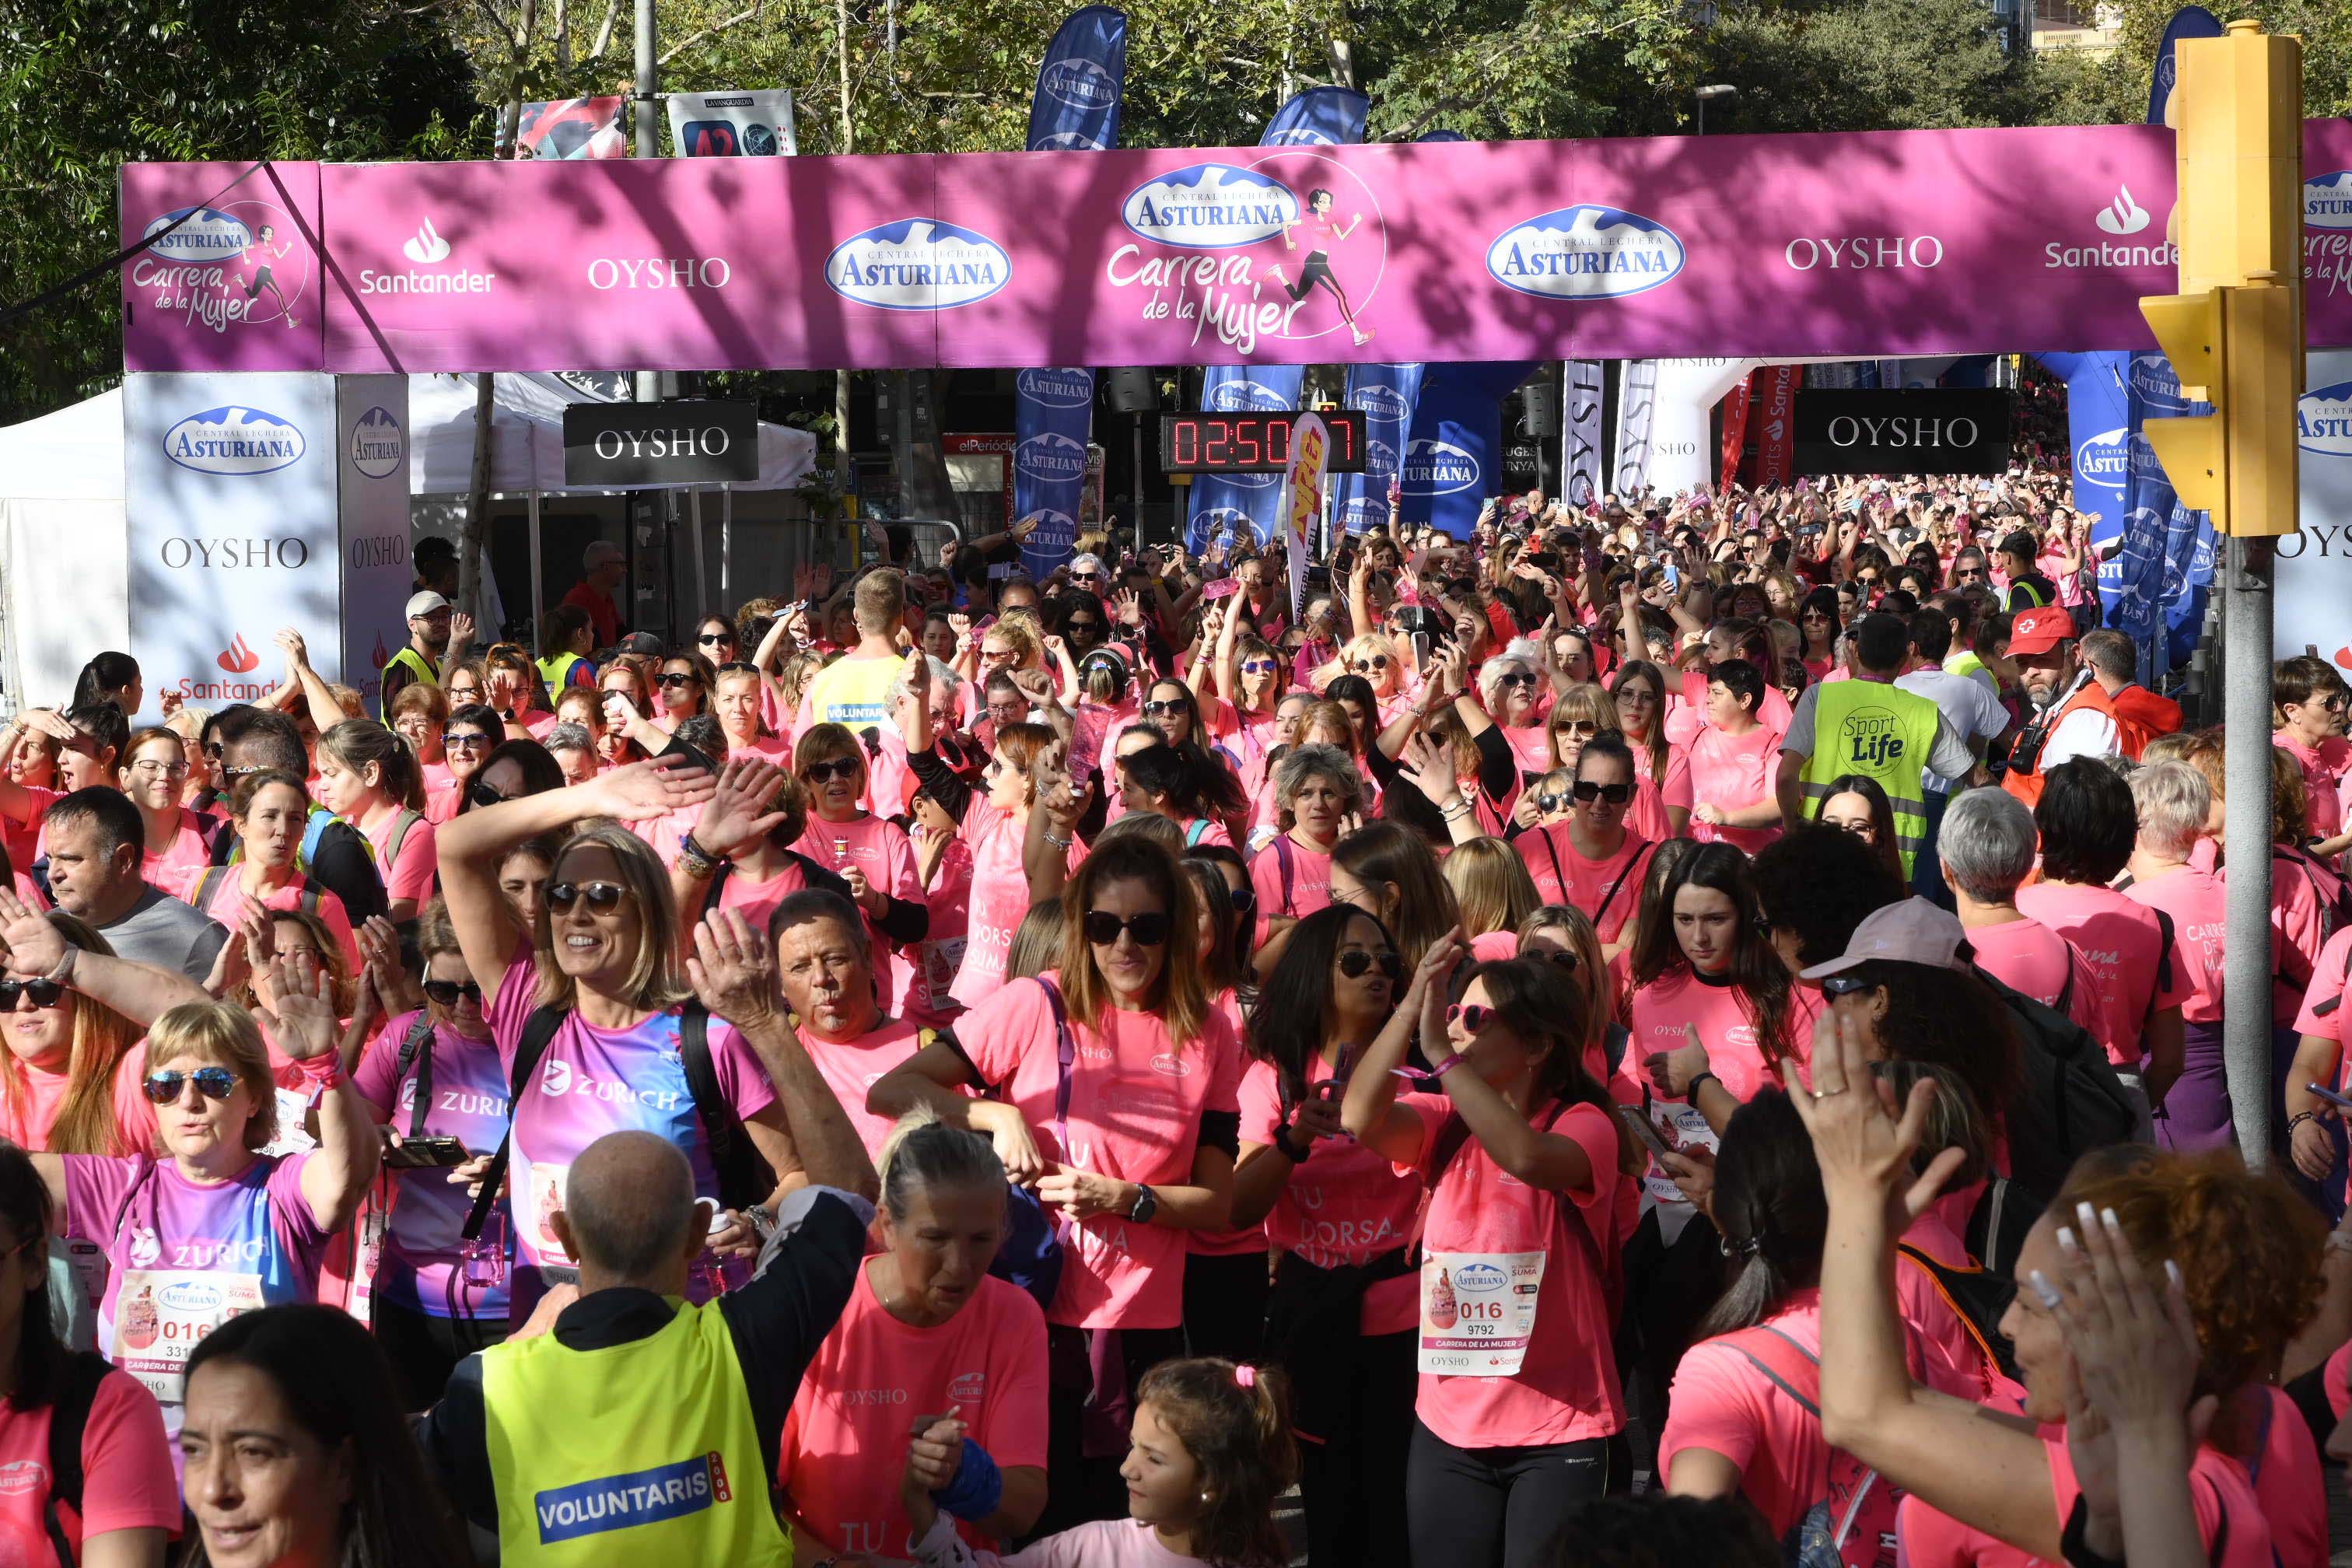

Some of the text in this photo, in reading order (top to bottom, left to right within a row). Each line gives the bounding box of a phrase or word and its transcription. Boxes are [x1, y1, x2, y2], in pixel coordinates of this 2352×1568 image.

[1047, 70, 1114, 100] ASTURIANA
[1135, 195, 1285, 227] ASTURIANA
[1162, 192, 1218, 202] CENTRAL
[1533, 236, 1662, 248] CENTRAL LECHERA
[1786, 235, 1943, 271] OYSHO
[132, 258, 224, 288] Carrera
[838, 253, 997, 287] ASTURIANA
[1107, 243, 1252, 287] Carrera
[1502, 242, 1669, 276] ASTURIANA
[2317, 257, 2331, 278] la
[360, 268, 495, 294] Santander
[587, 257, 731, 290] OYSHO
[156, 285, 258, 333] de la Mujer
[1143, 282, 1306, 355] de la Mujer
[1023, 373, 1089, 398] ASTURIANA
[1353, 394, 1404, 417] ASTURIANA
[174, 432, 295, 458] ASTURIANA
[595, 425, 730, 460] OYSHO
[1828, 415, 1978, 448] OYSHO
[355, 442, 399, 461] ASTURIANA
[1020, 448, 1083, 471] ASTURIANA
[161, 537, 308, 569] OYSHO
[353, 534, 404, 569] OYSHO
[1844, 715, 1896, 737] Sport
[1851, 733, 1903, 766] Life
[576, 1073, 677, 1111] ZURICH
[1288, 1185, 1322, 1209] TU
[173, 1236, 271, 1269] ZURICH
[1458, 1273, 1503, 1285] ASTURIANA
[163, 1290, 217, 1306] ASTURIANA
[228, 1290, 255, 1300] SUMA
[1461, 1302, 1503, 1319] 016
[163, 1321, 212, 1340] 016
[1468, 1325, 1495, 1335] 9792
[127, 1360, 180, 1372] CARRERA DE
[1431, 1356, 1469, 1367] OYSHO
[843, 1388, 908, 1406] OYSHO
[710, 1452, 728, 1501] 2000
[538, 1472, 708, 1529] VOLUNTARIS
[840, 1521, 886, 1555] TU
